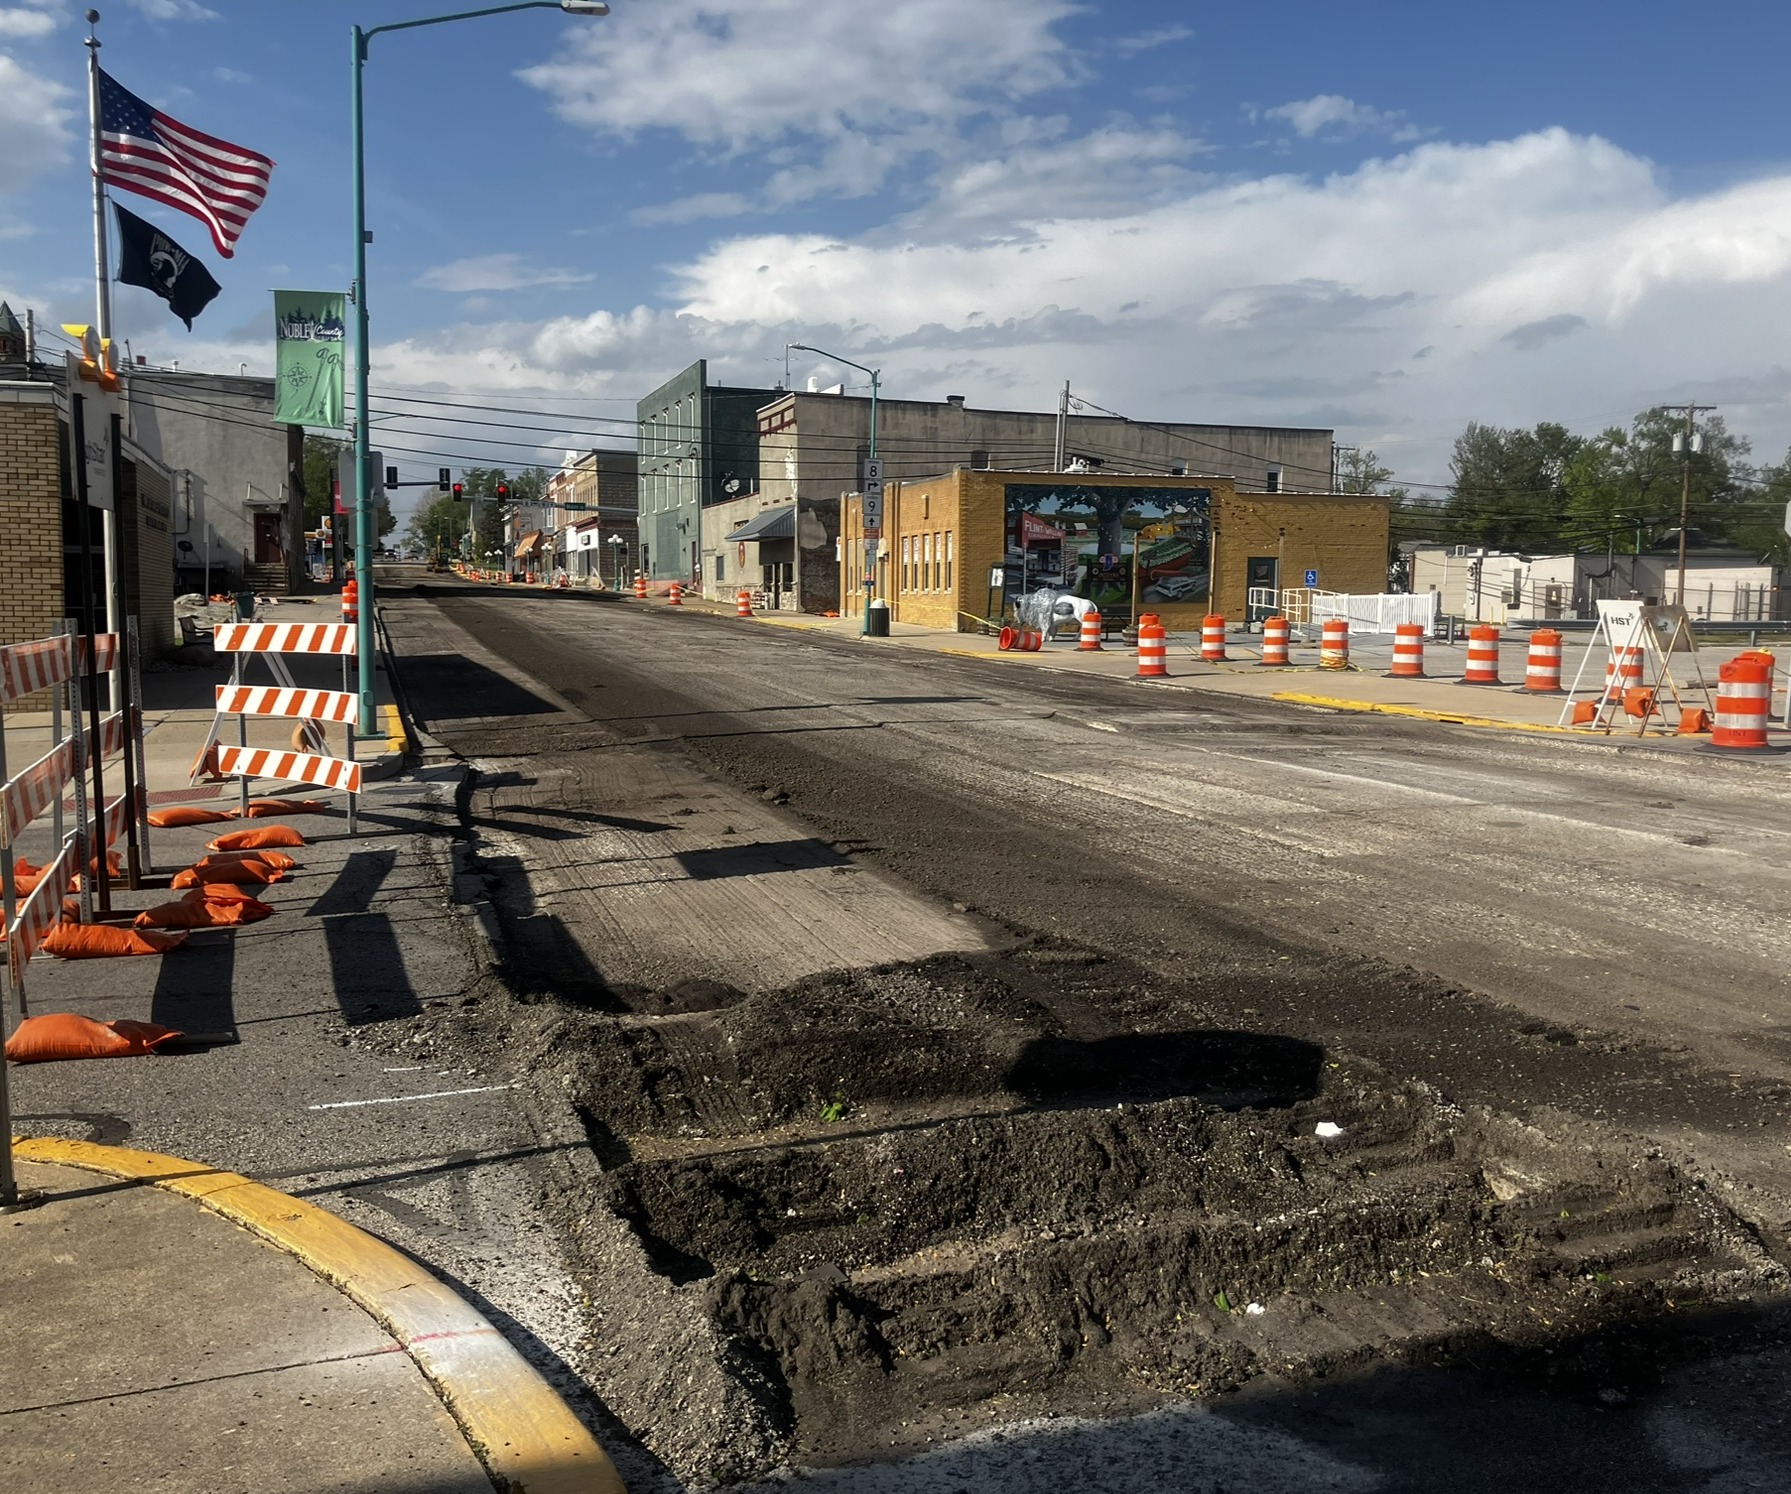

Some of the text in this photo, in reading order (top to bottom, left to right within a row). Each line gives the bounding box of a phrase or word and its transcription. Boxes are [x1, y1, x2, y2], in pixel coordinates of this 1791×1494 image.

[280, 318, 344, 341] NOBLE County
[869, 465, 877, 477] 8
[868, 501, 876, 512] 9
[1025, 520, 1044, 533] FLINT
[1611, 616, 1631, 626] HST
